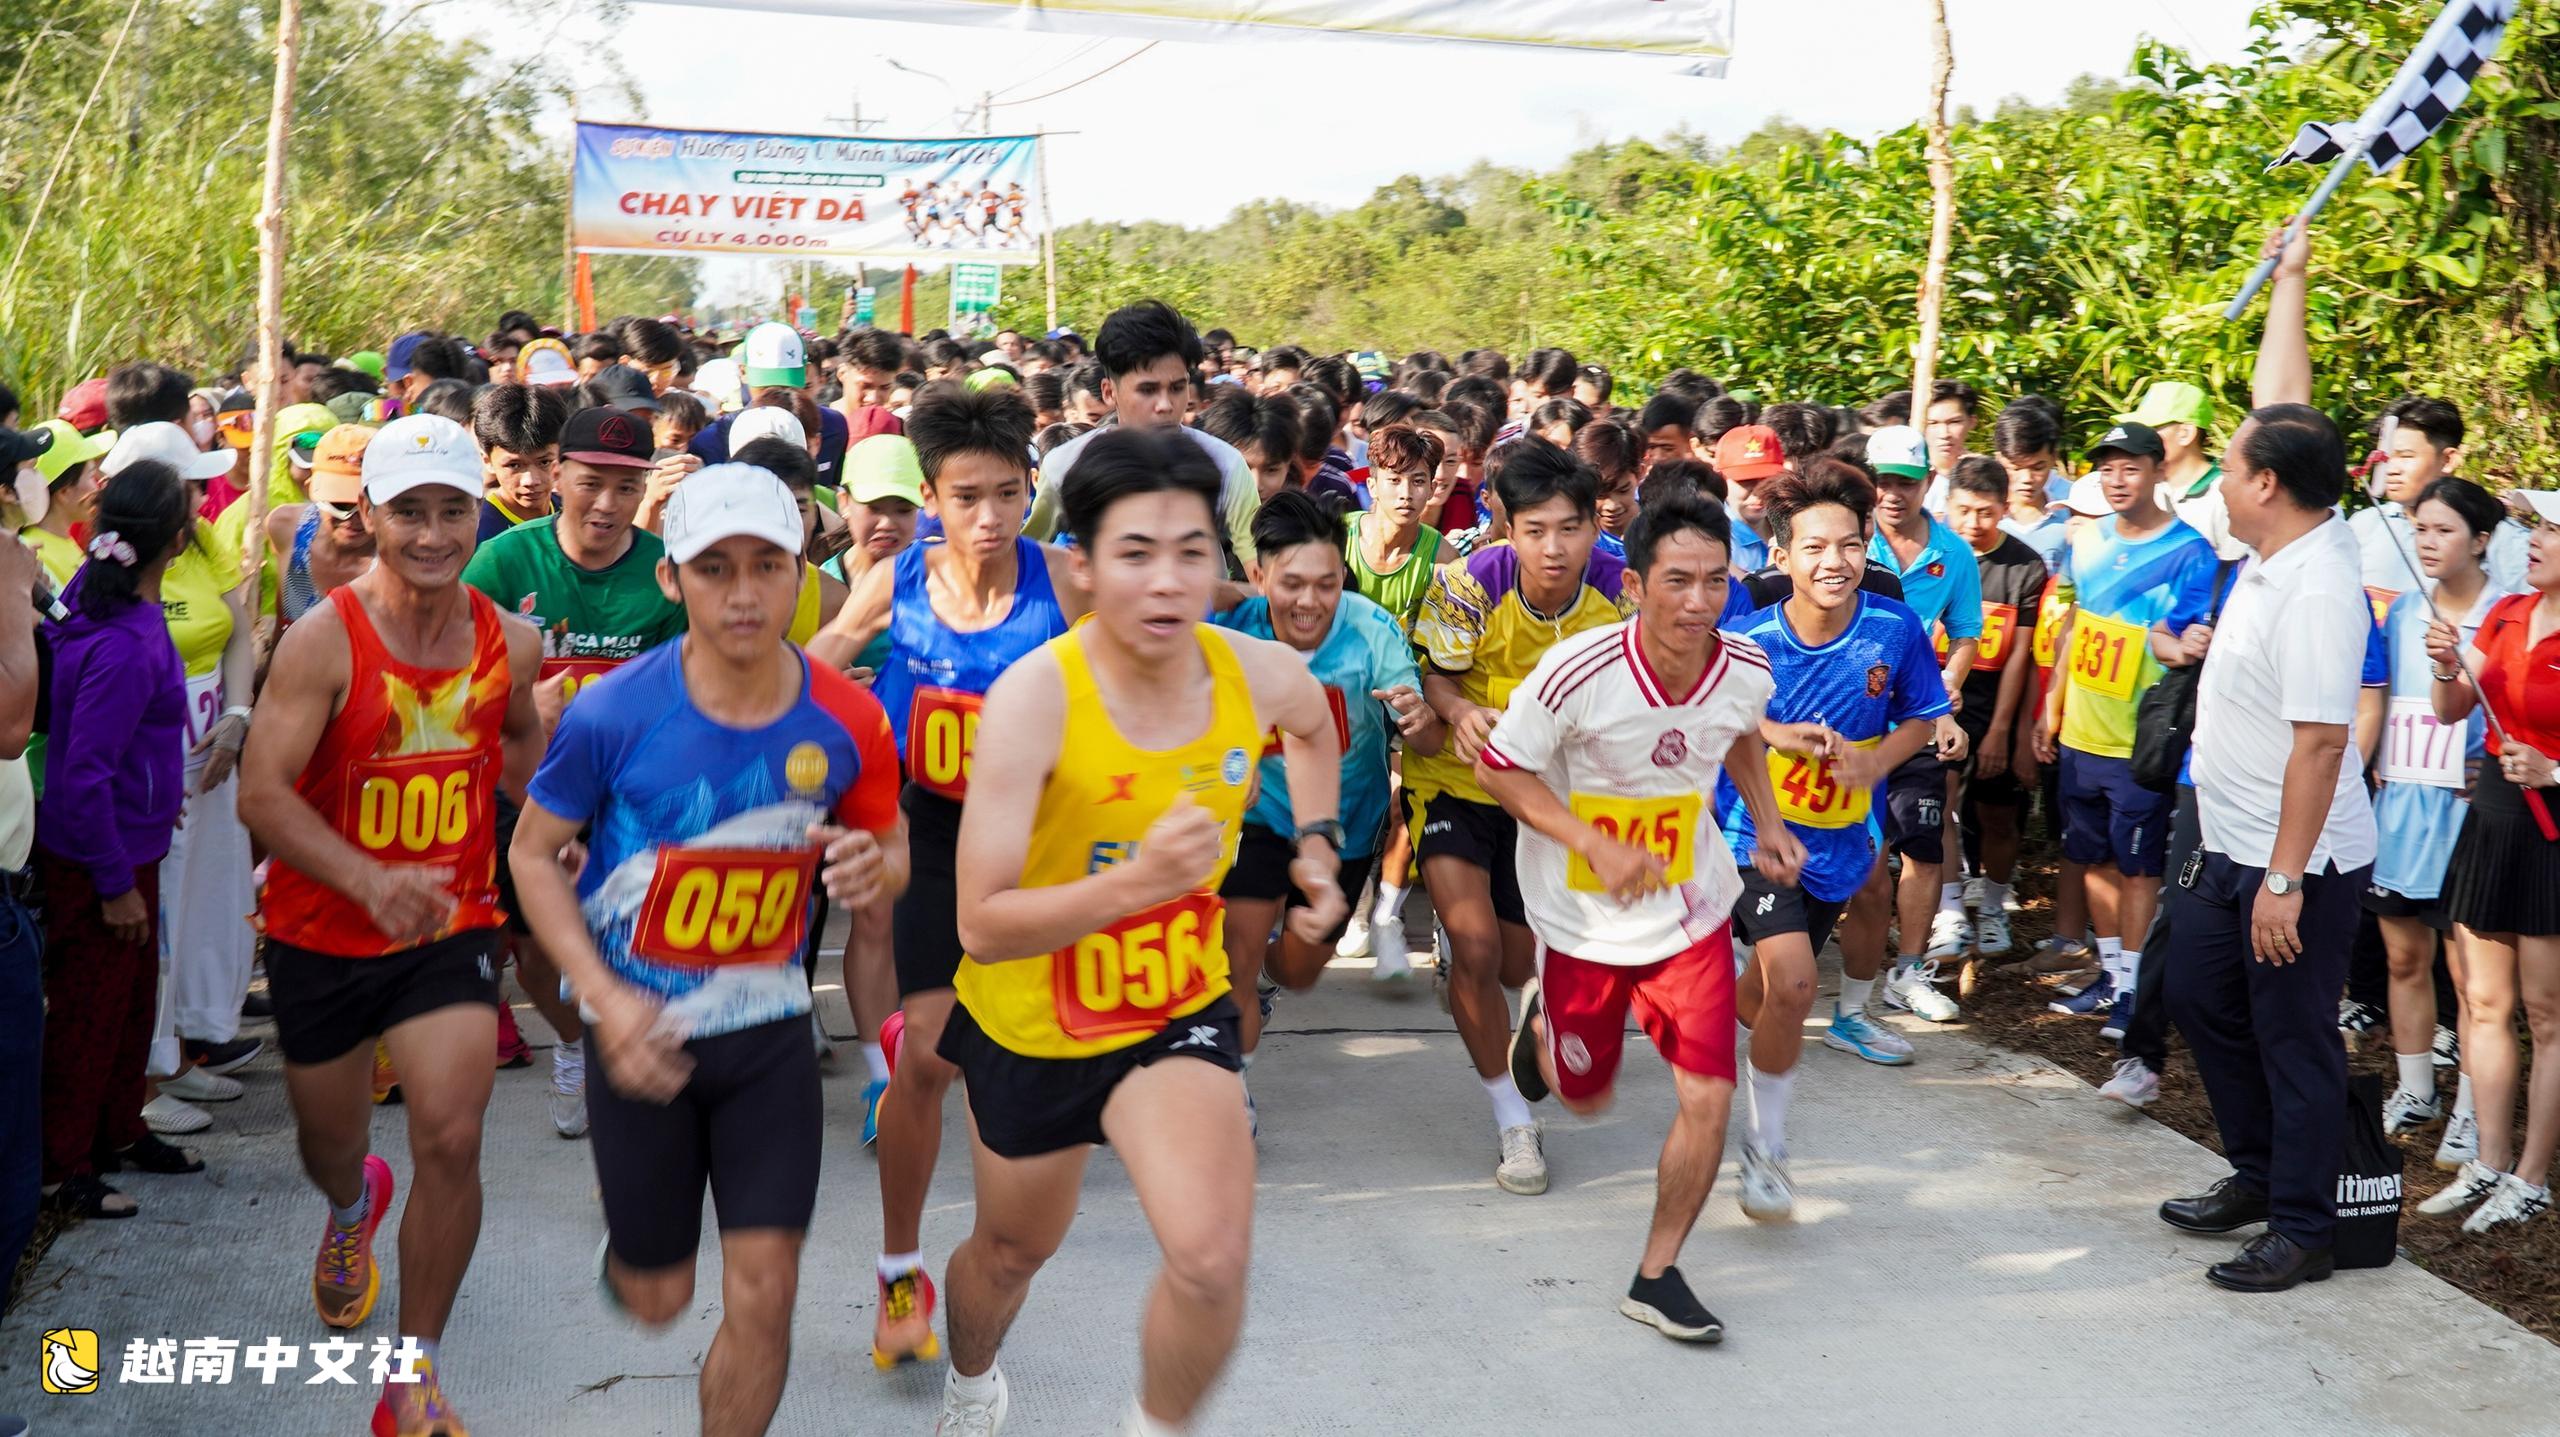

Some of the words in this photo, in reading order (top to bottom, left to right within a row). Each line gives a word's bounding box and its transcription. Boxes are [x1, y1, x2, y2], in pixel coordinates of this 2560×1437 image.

[837, 142, 884, 162] Minh
[619, 191, 720, 223] CHẠY
[732, 191, 807, 227] VIỆT
[816, 193, 866, 222] DÃ
[730, 233, 828, 248] 4.000m
[2076, 626, 2128, 683] 331
[358, 769, 470, 852] 006
[1918, 806, 1940, 826] 10
[663, 866, 800, 955] 059
[2360, 1203, 2399, 1216] FASHION
